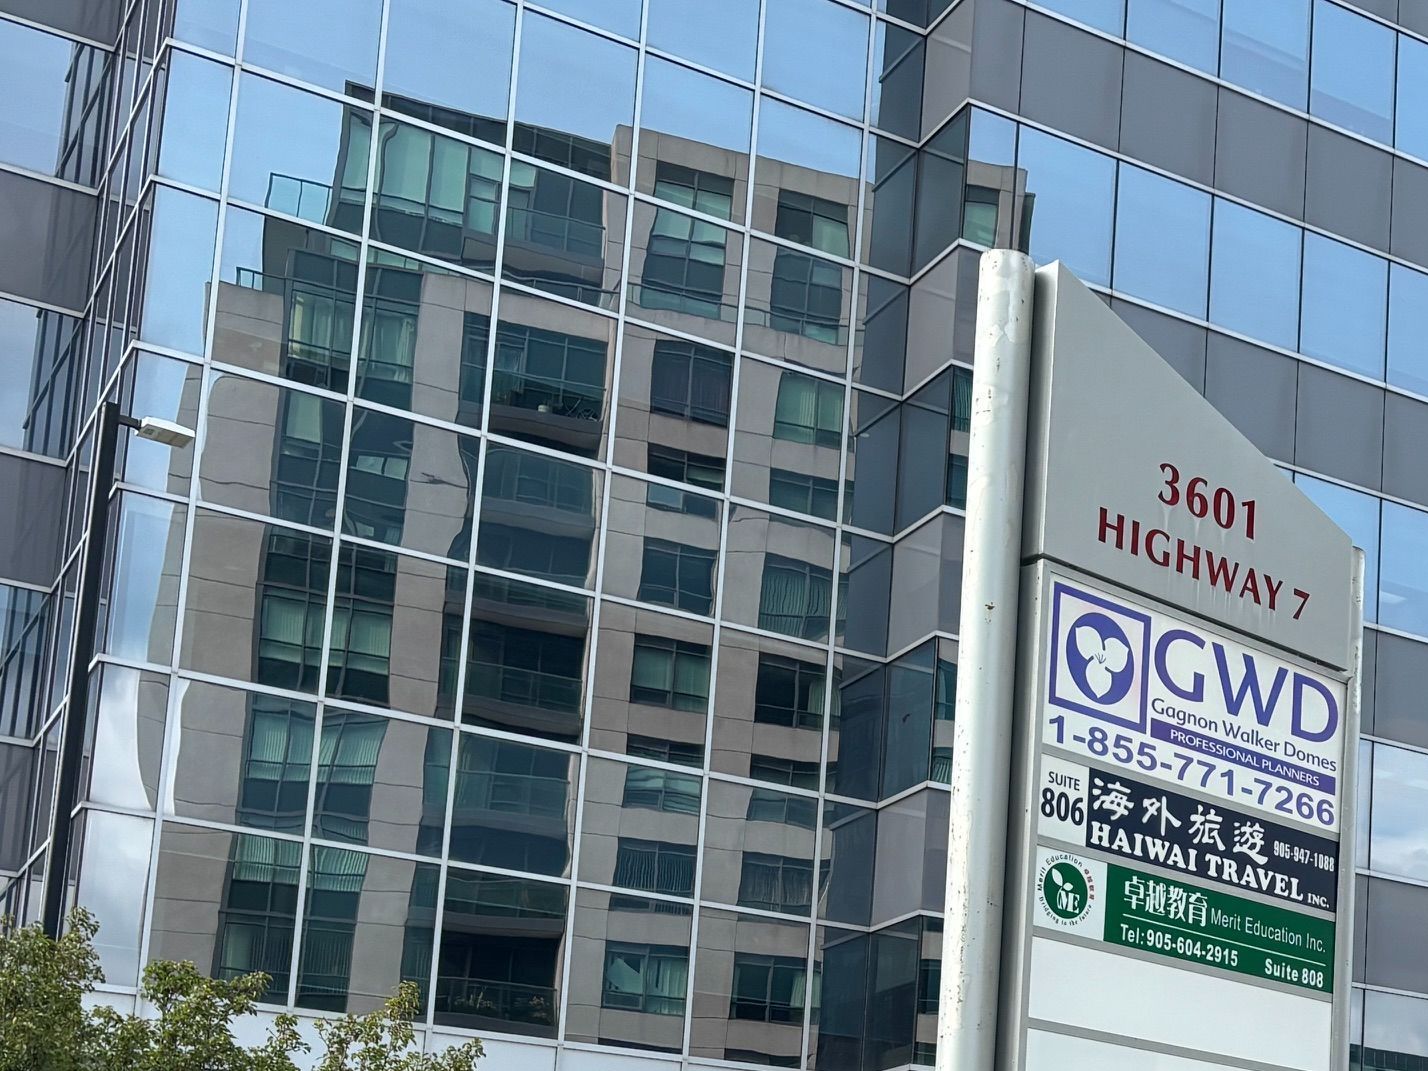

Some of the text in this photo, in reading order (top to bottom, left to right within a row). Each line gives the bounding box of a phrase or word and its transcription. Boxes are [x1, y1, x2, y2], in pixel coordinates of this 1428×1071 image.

[1157, 462, 1255, 540] 3601
[1098, 506, 1310, 620] HIGHWAY 7
[1154, 629, 1338, 742] GWD
[1152, 697, 1337, 772] Gagnon Walker Domes
[1170, 729, 1319, 786] PROFESSIONAL PLANNERS
[1048, 771, 1080, 791] SUITE
[1049, 714, 1335, 826] 1-855-771-7266
[1041, 787, 1084, 826] 806
[1092, 777, 1269, 865] 海外旅遊
[1090, 821, 1330, 909] HAIWAI TRAVEL INC.
[1273, 840, 1335, 872] 905-947-1088
[1123, 876, 1208, 927] 卓越教育
[1211, 906, 1326, 953] Merit Education Inc.
[1146, 928, 1238, 967] 905-604-2915
[1264, 958, 1324, 989] Suite 808
